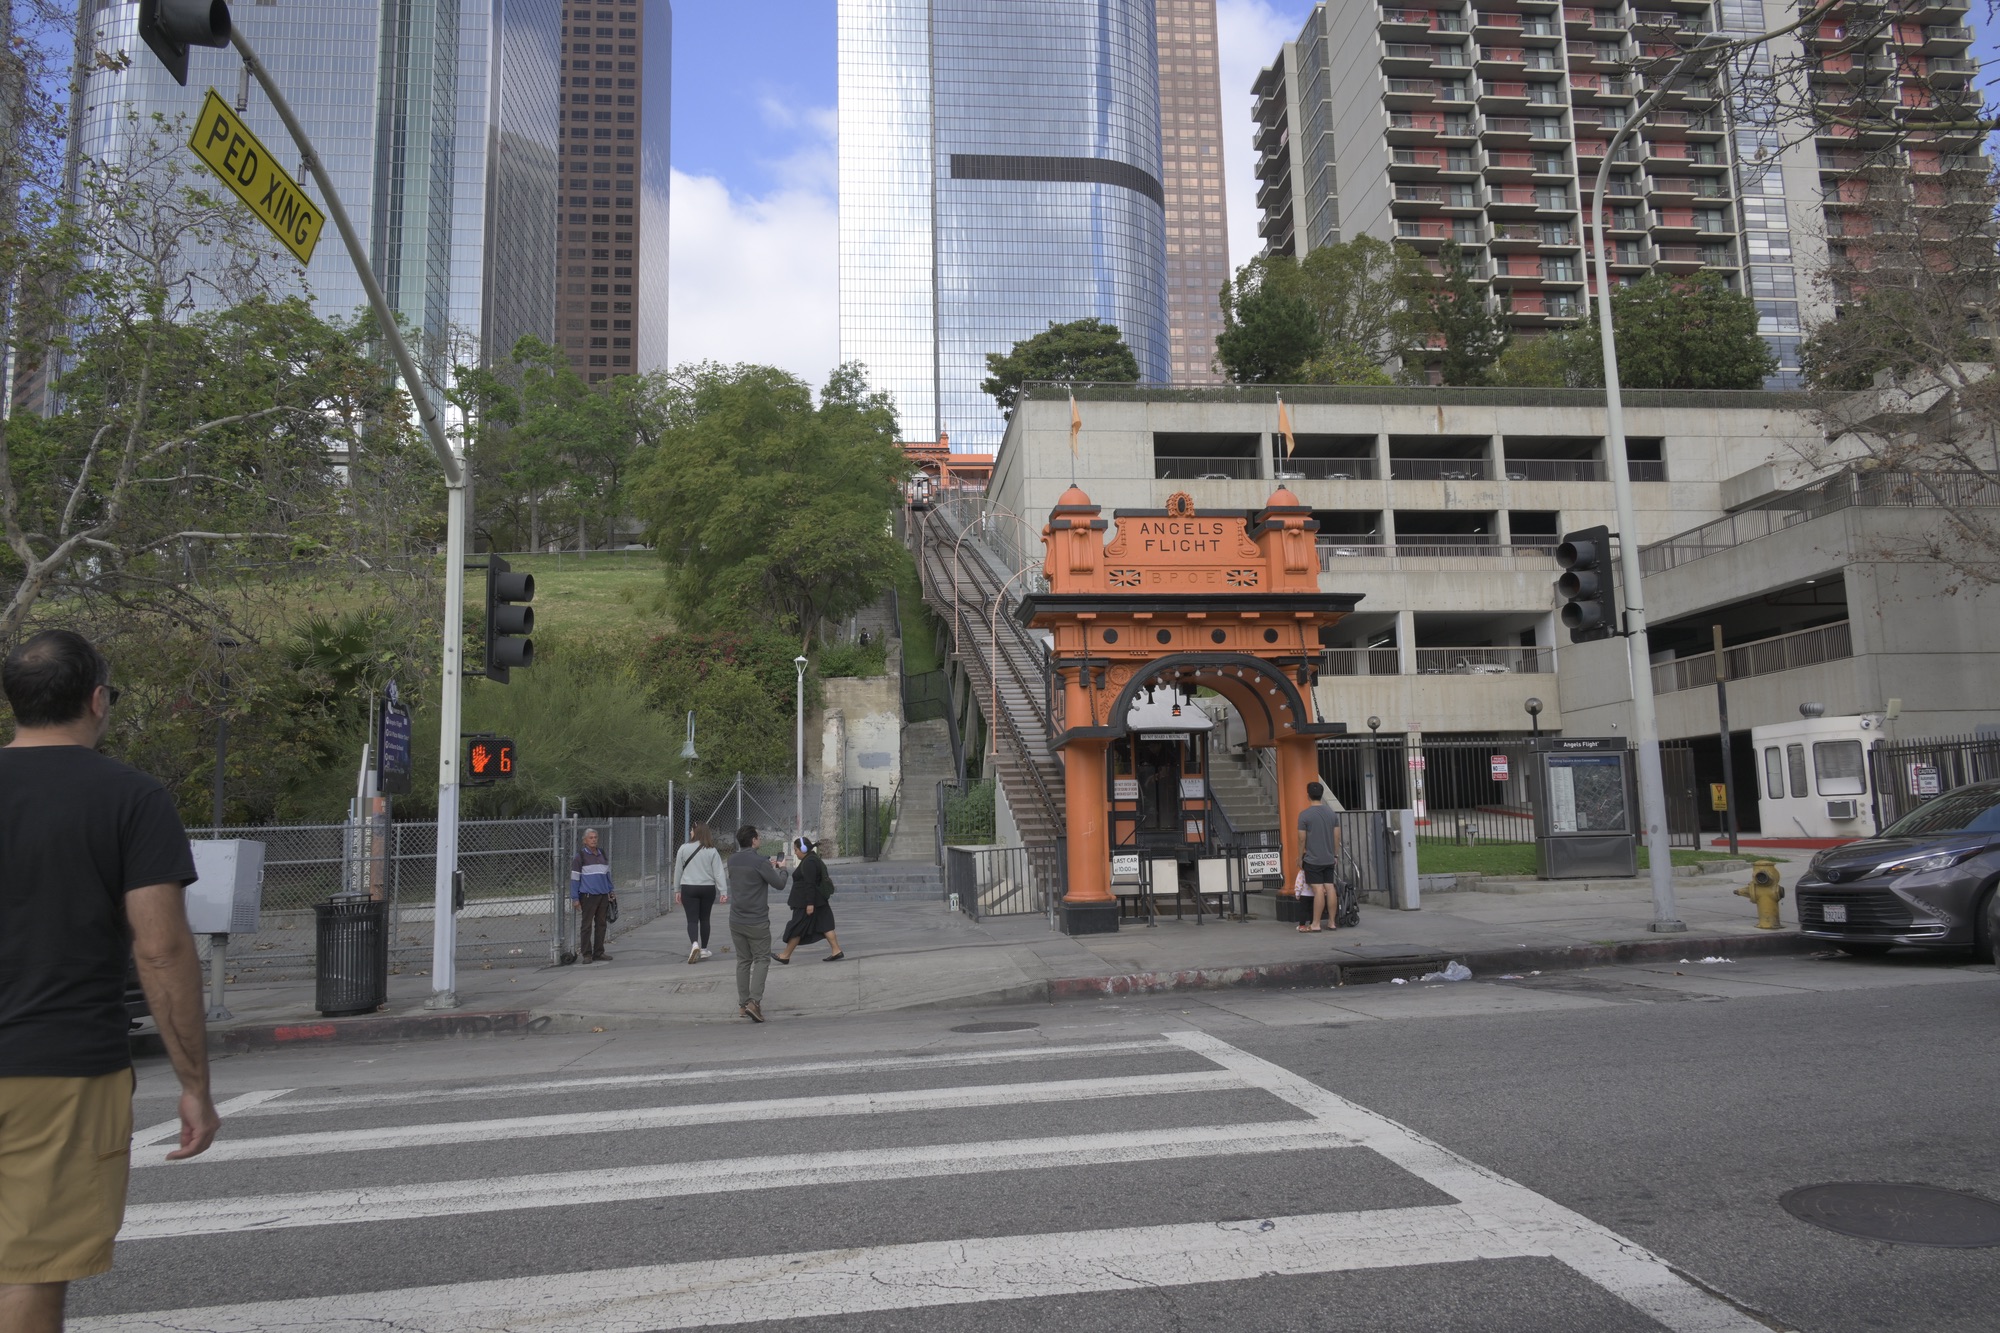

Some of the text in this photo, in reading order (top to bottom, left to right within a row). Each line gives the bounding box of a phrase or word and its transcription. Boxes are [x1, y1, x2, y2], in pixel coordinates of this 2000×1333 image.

[206, 113, 312, 245] PED XING
[1140, 522, 1224, 535] ANGELS
[1145, 539, 1221, 552] FLIGHT
[500, 747, 511, 772] 6
